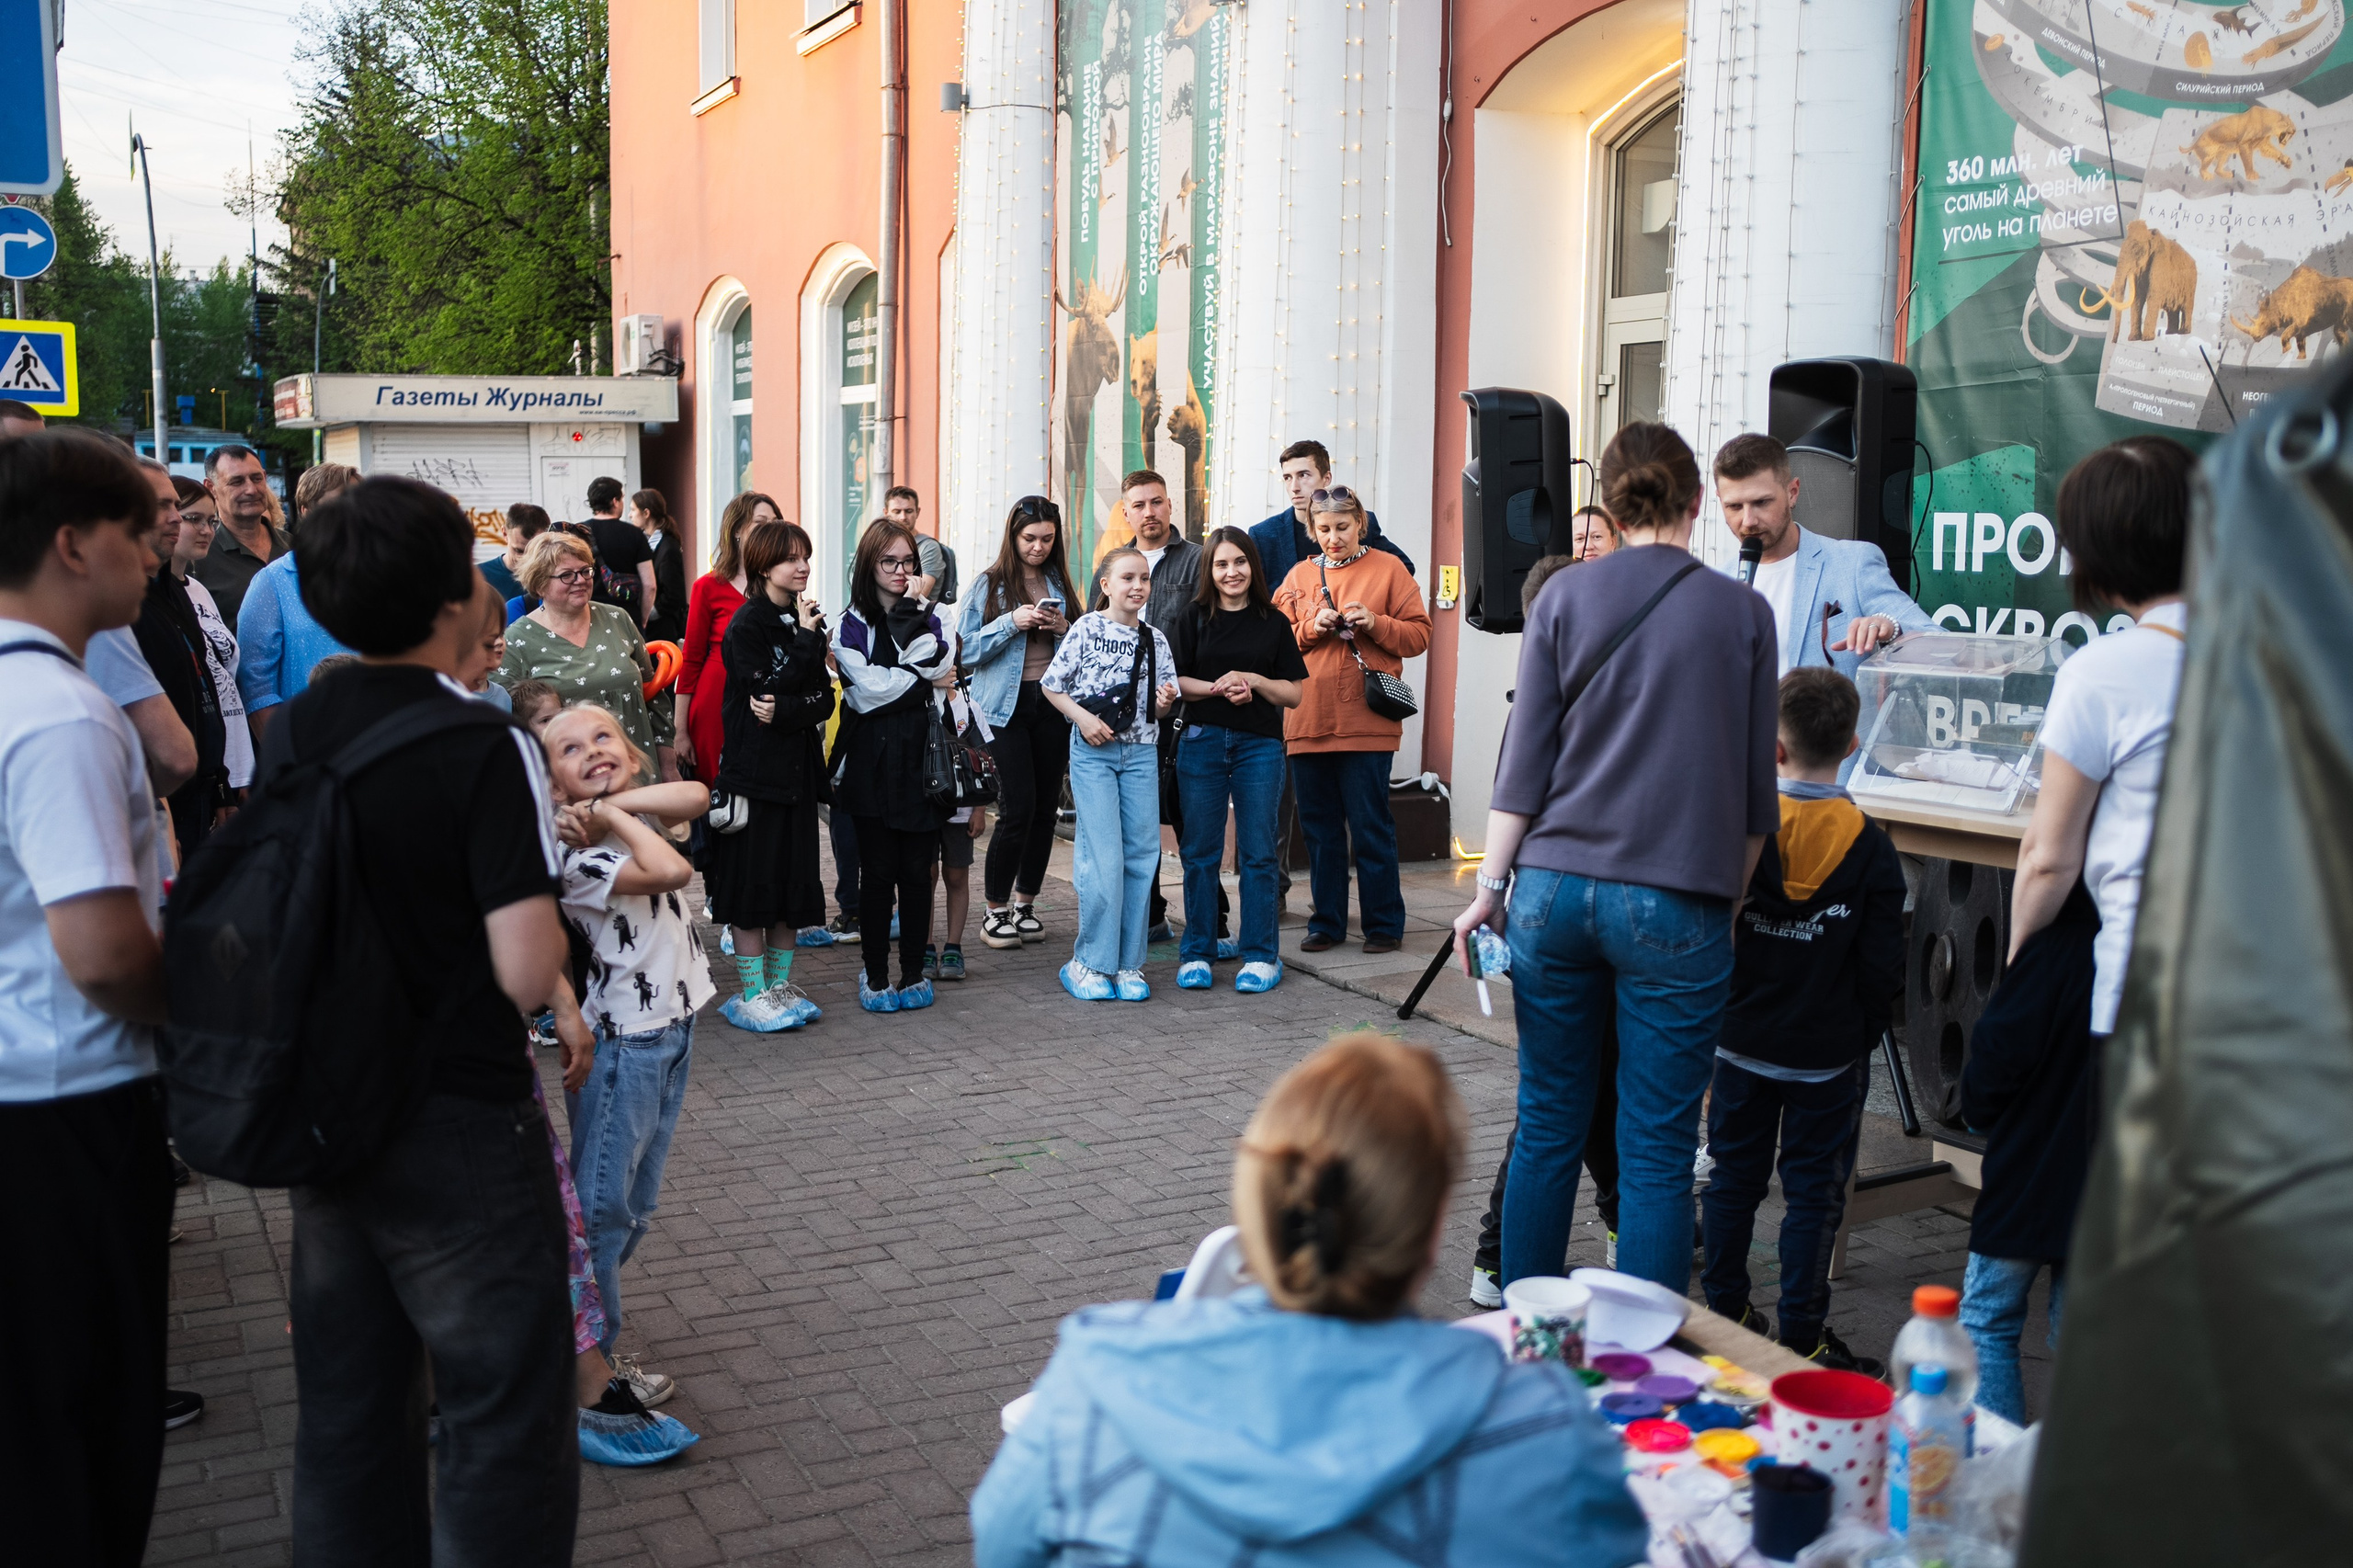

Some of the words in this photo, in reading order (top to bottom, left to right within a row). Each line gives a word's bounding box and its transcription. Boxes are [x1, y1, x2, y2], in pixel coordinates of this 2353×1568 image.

[1153, 30, 1164, 94] МИРА
[1209, 14, 1221, 110] ЗНАНИЙ
[2041, 27, 2081, 55] ДЕВОНСКИЙ
[2080, 49, 2106, 70] ПЕРИОД
[2305, 31, 2335, 58] ПЕРИОД
[1082, 63, 1092, 157] НАЕДИНЕ
[2176, 82, 2231, 95] СИЛУРИЙСКИЙ
[2232, 82, 2265, 94] ПЕРИОД
[1091, 60, 1101, 176] ПРИРОДОЙ
[1141, 35, 1153, 202] РАЗНООБРАЗИЕ
[1206, 117, 1218, 245] МАРАФОНЕ
[1946, 155, 1984, 184] 360
[1990, 152, 2037, 176] млн.
[2045, 143, 2084, 167] лет
[1081, 163, 1090, 243] ПОБУДЬ
[1091, 183, 1098, 199] С
[1149, 100, 1161, 276] ОКРУЖАЮЩЕГО
[1944, 183, 2008, 214] самый
[2013, 167, 2107, 208] древний
[1942, 222, 1993, 251] уголь
[1997, 215, 2022, 238] на
[2029, 204, 2118, 233] планете
[2149, 205, 2295, 227] КАЙНОЗОЙСКАЯ
[2316, 201, 2353, 222] ЭРА
[1139, 210, 1148, 295] ОТКРОЙ
[1205, 253, 1214, 267] В
[1203, 274, 1215, 389] УЧАСТВУЙ
[2115, 356, 2146, 369] ГОЛОЦЕН
[2157, 366, 2206, 381] ПЛЕЙСТОЦЕН
[375, 385, 479, 407] Газеты
[484, 386, 604, 412] Журналы
[2132, 401, 2164, 417] ПЕРИОД
[1933, 512, 2075, 575] ПРО
[1094, 637, 1137, 656] CHOOS
[1754, 923, 1813, 941] COLLECTION
[1795, 920, 1824, 933] WEAR
